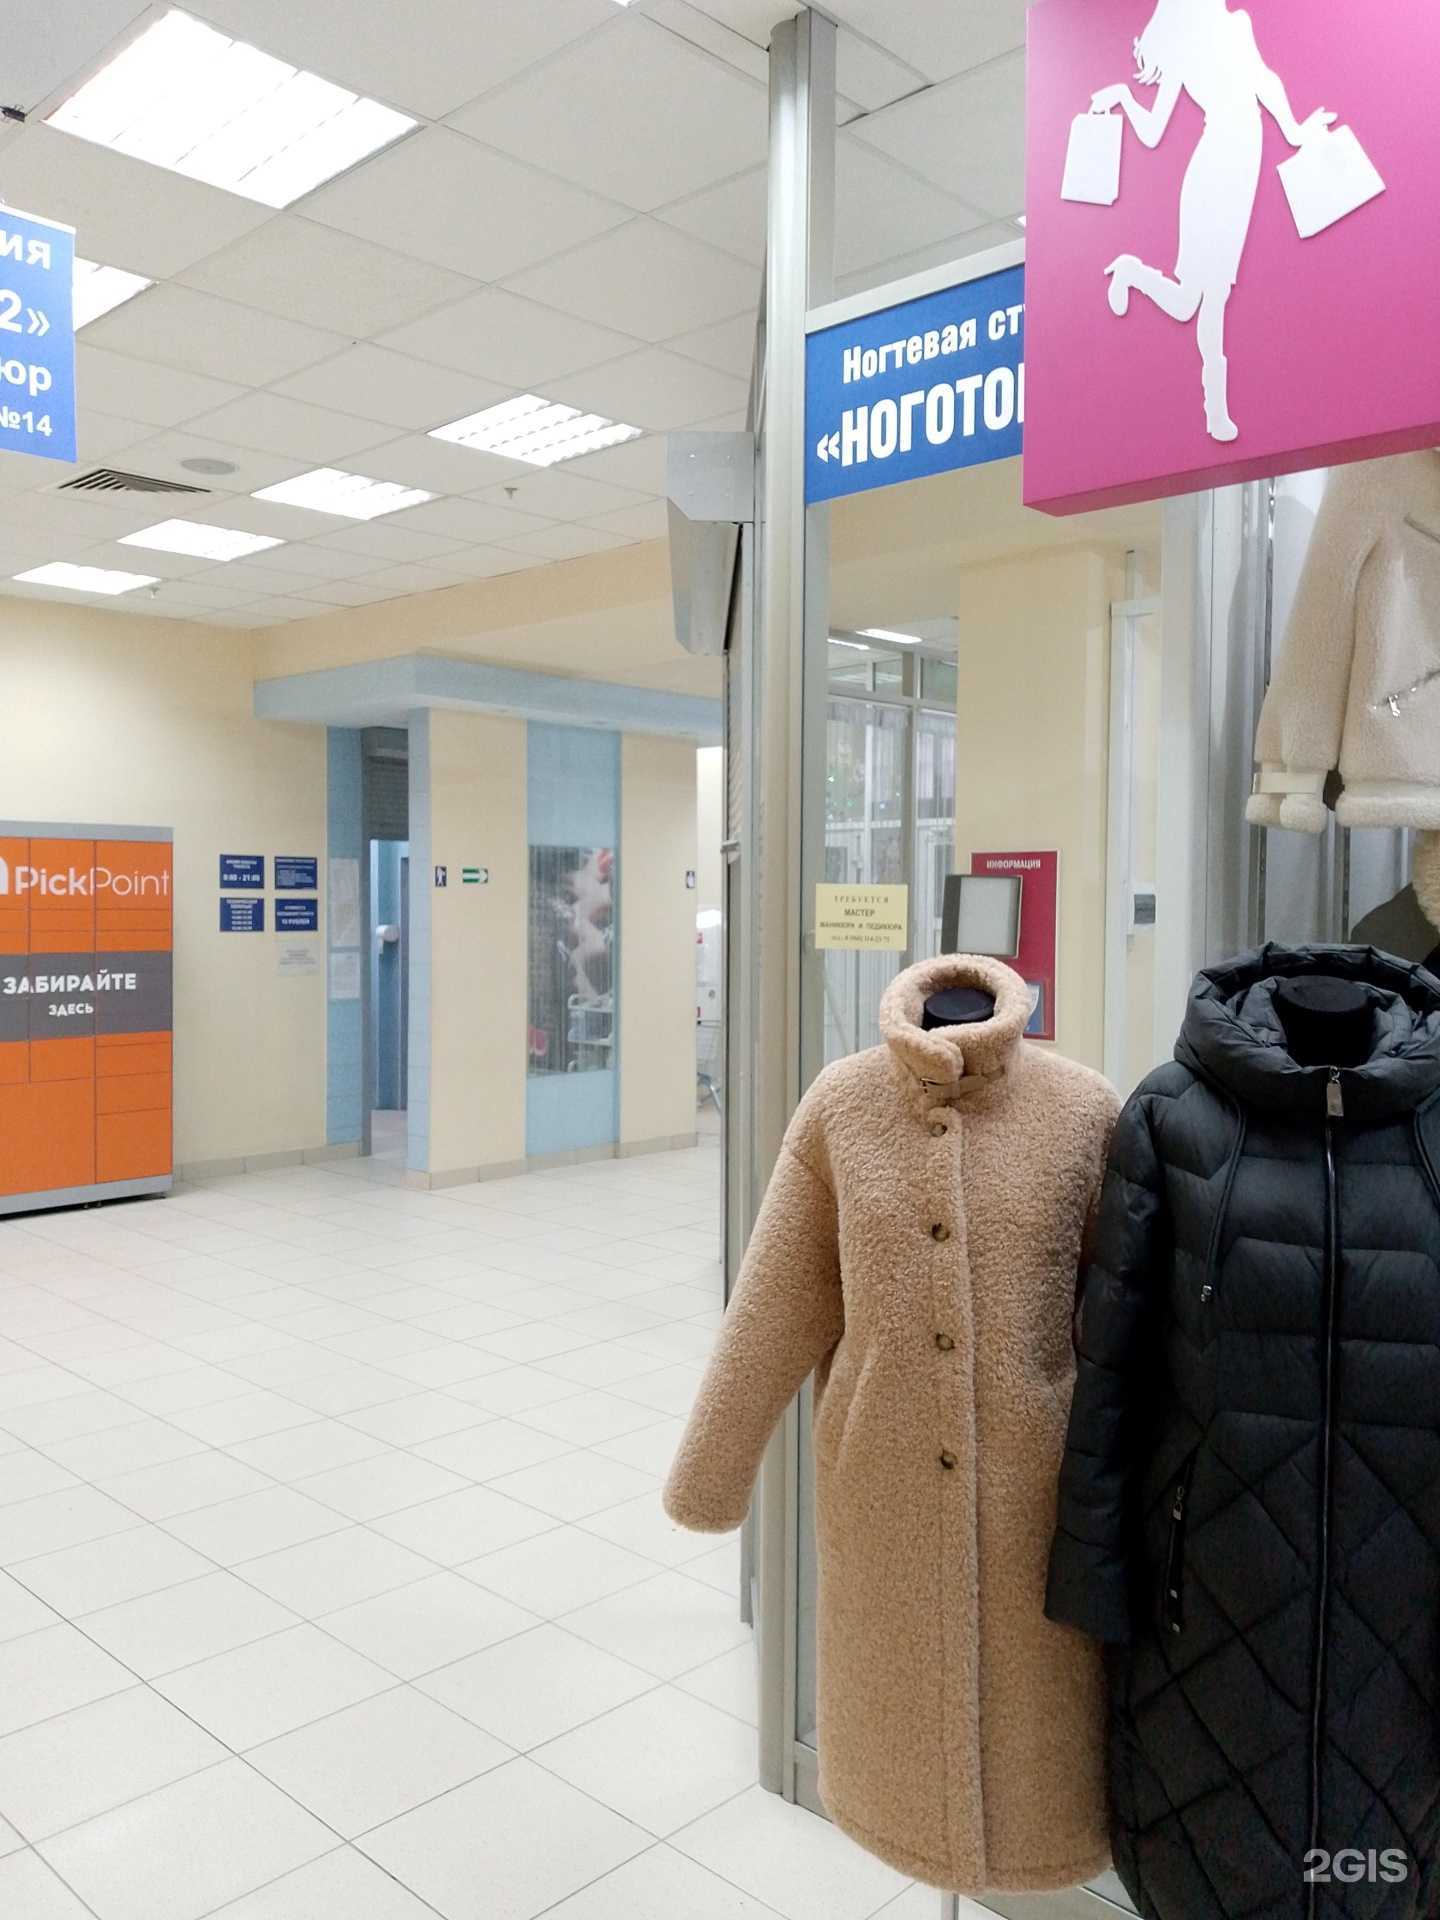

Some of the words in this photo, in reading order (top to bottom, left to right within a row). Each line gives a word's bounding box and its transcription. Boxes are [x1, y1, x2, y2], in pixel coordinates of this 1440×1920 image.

[842, 318, 977, 384] Ногтевая
[988, 304, 1026, 341] ст
[986, 859, 1041, 869] ИНФОРМАЦИЯ
[15, 865, 170, 896] PickPoint
[844, 908, 876, 917] МАСТЕР
[3, 969, 137, 994] ЗАБИРАЙТЕ
[48, 1003, 94, 1016] ЗДЕСЬ
